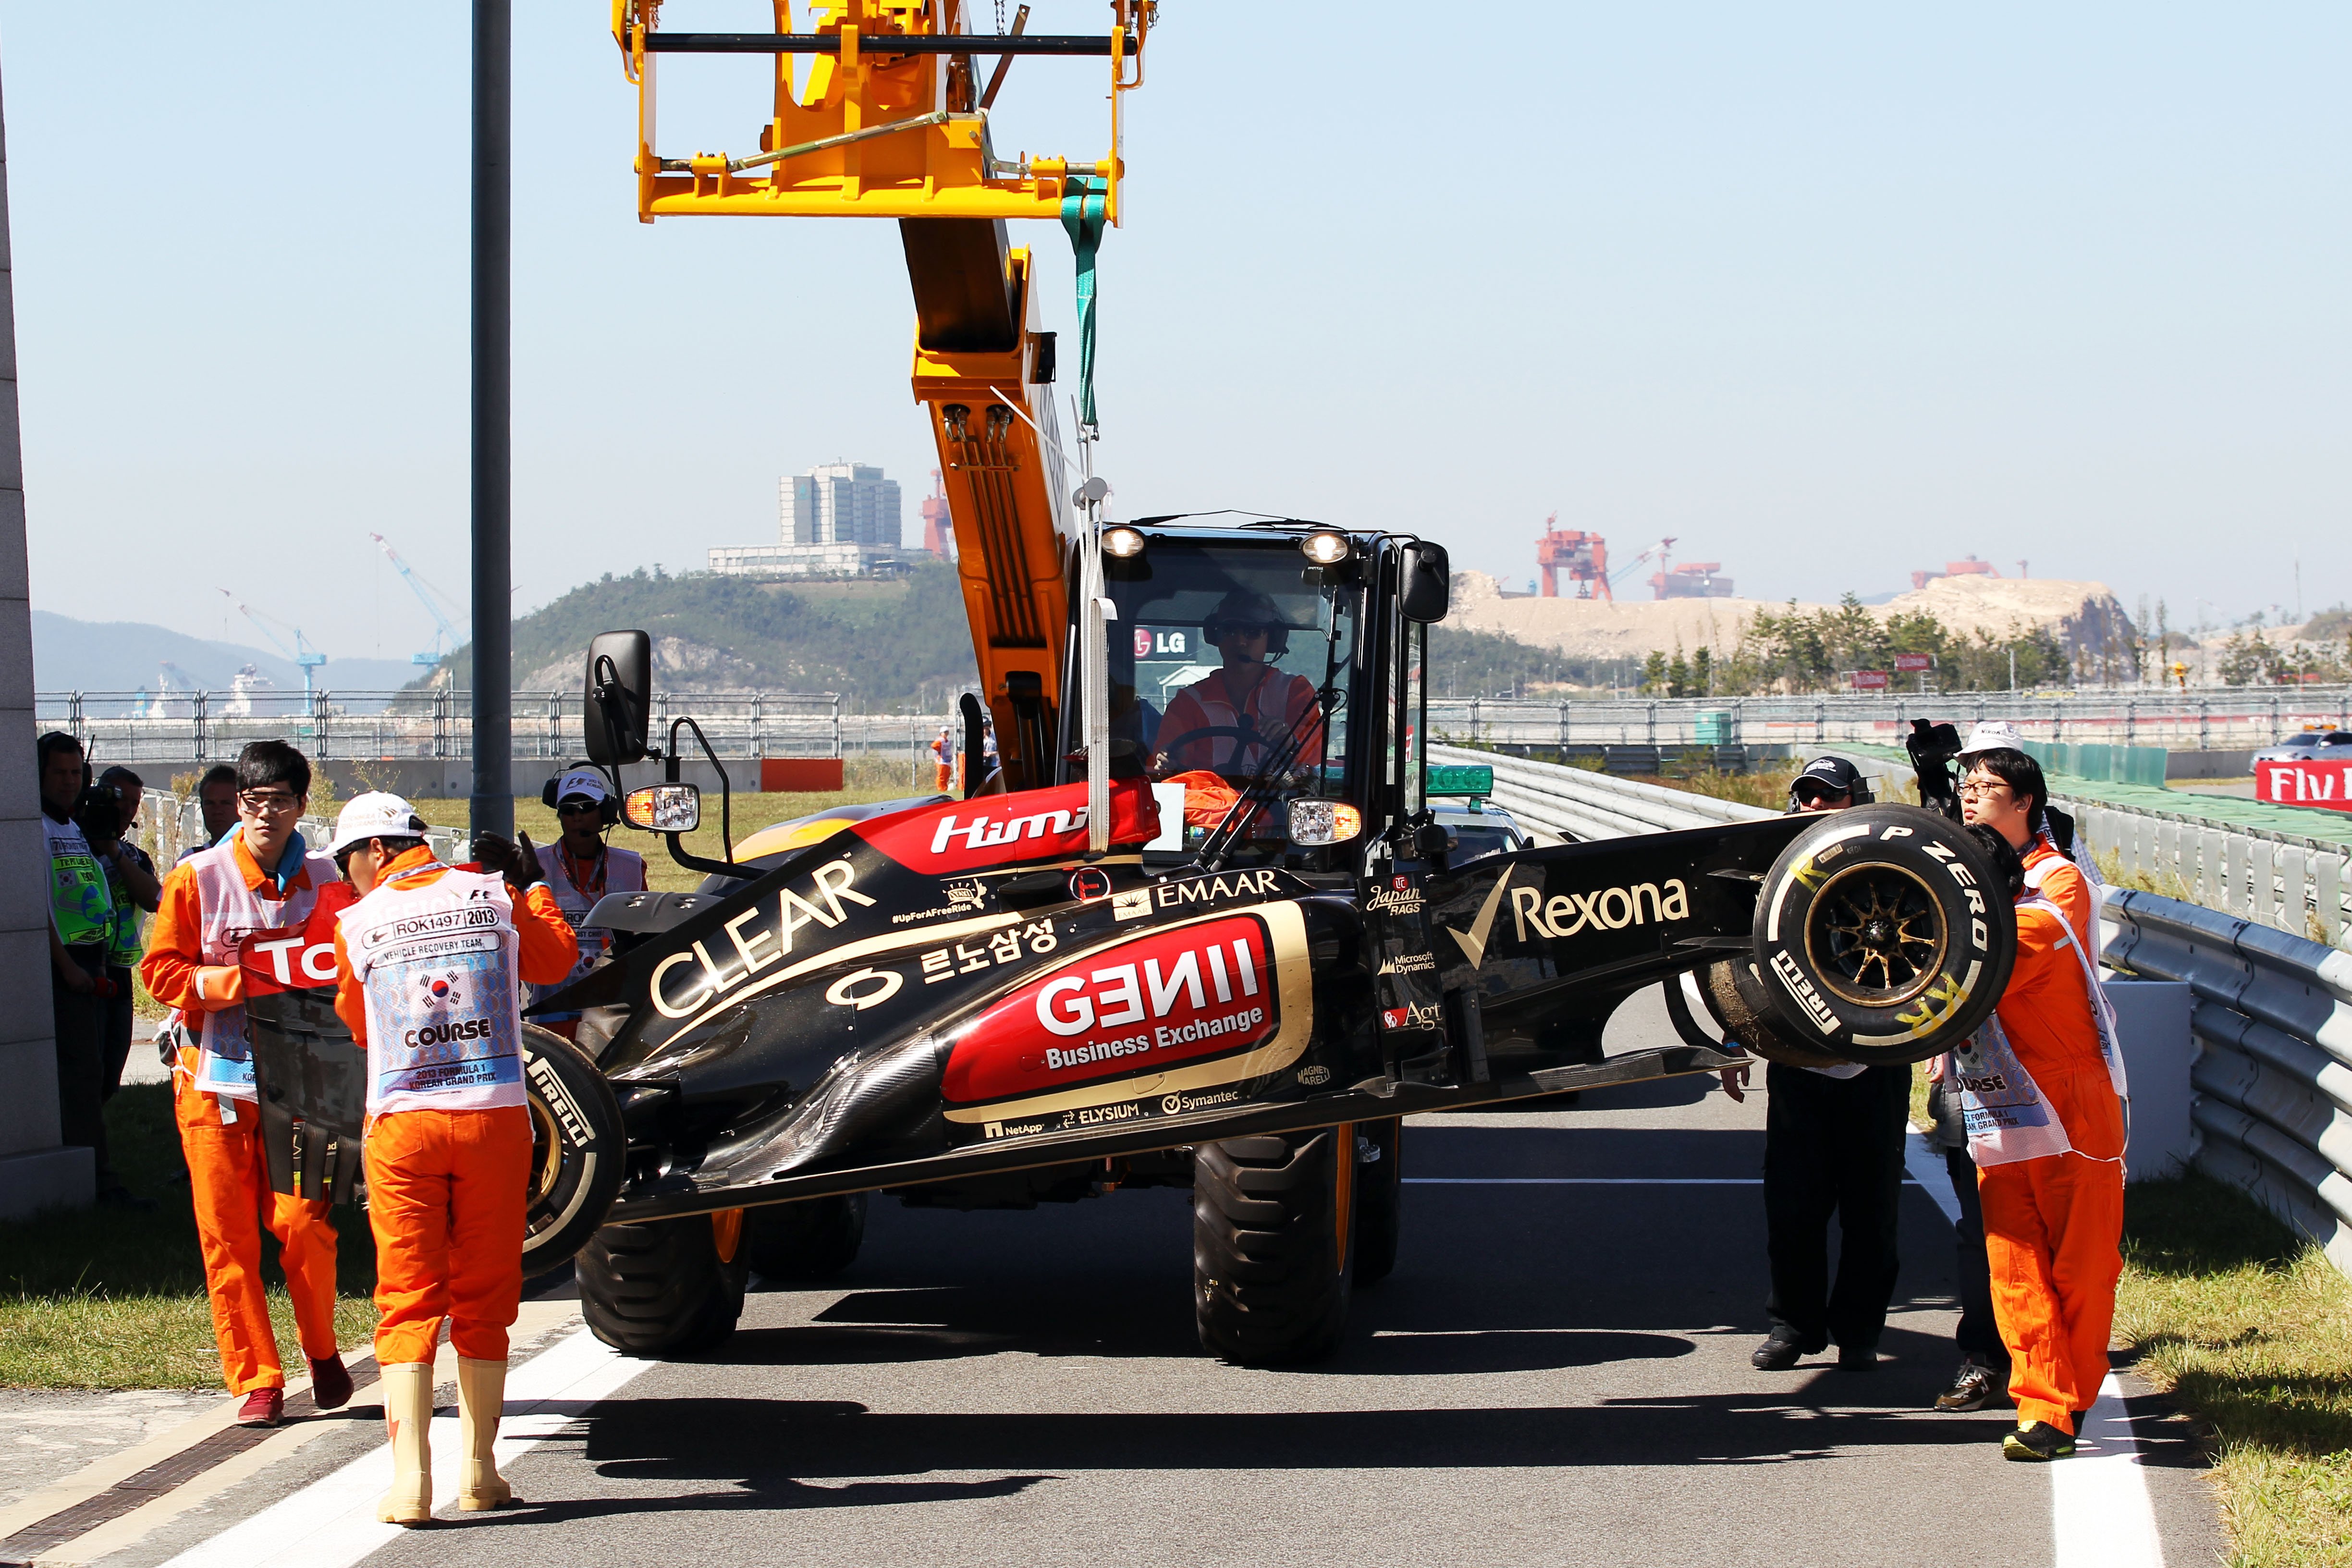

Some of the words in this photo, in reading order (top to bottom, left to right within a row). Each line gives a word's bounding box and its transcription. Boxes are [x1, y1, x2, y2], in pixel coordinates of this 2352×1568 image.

[1156, 632, 1185, 653] LG
[1157, 870, 1281, 907] EMAAR
[1366, 885, 1422, 911] Japan
[1880, 826, 1913, 841] P
[1922, 841, 1987, 952] ZERO
[396, 915, 460, 935] ROK1497
[467, 909, 495, 925] 2013
[892, 903, 971, 923] #UpForAFreeRide
[1118, 907, 1148, 919] EMAAR
[1390, 903, 1421, 916] RAGS
[1511, 879, 1689, 942] Rexona
[384, 949, 416, 960] VEHICLE
[418, 941, 458, 954] RECOVERY
[462, 938, 482, 948] TEAM
[650, 859, 877, 1018] CLEAR
[920, 918, 1058, 985] 르노삼성
[1395, 952, 1433, 965] Microsoft
[1396, 961, 1435, 975] Dynamics
[1036, 938, 1258, 1036] GENII
[1770, 949, 1841, 1035] PIRELLI
[1402, 1001, 1443, 1030] Agt
[404, 1018, 491, 1048] COURSE
[1045, 1033, 1150, 1069] Business
[1154, 1007, 1263, 1048] Exchange
[409, 1079, 444, 1090] KOREAN
[445, 1075, 475, 1086] GRAND
[477, 1072, 497, 1081] PRIX
[416, 1068, 438, 1079] 2013
[439, 1064, 478, 1077] FORMULA
[1957, 1074, 2007, 1092] URSE
[527, 1057, 596, 1148] PIRELLI
[1005, 1124, 1043, 1136] NetApp
[1078, 1104, 1139, 1125] ELYSIUM
[1182, 1090, 1239, 1109] Symantec
[1971, 1111, 2003, 1122] FORMULA
[1978, 1118, 2002, 1129] GRAND
[2003, 1117, 2019, 1126] PRIX
